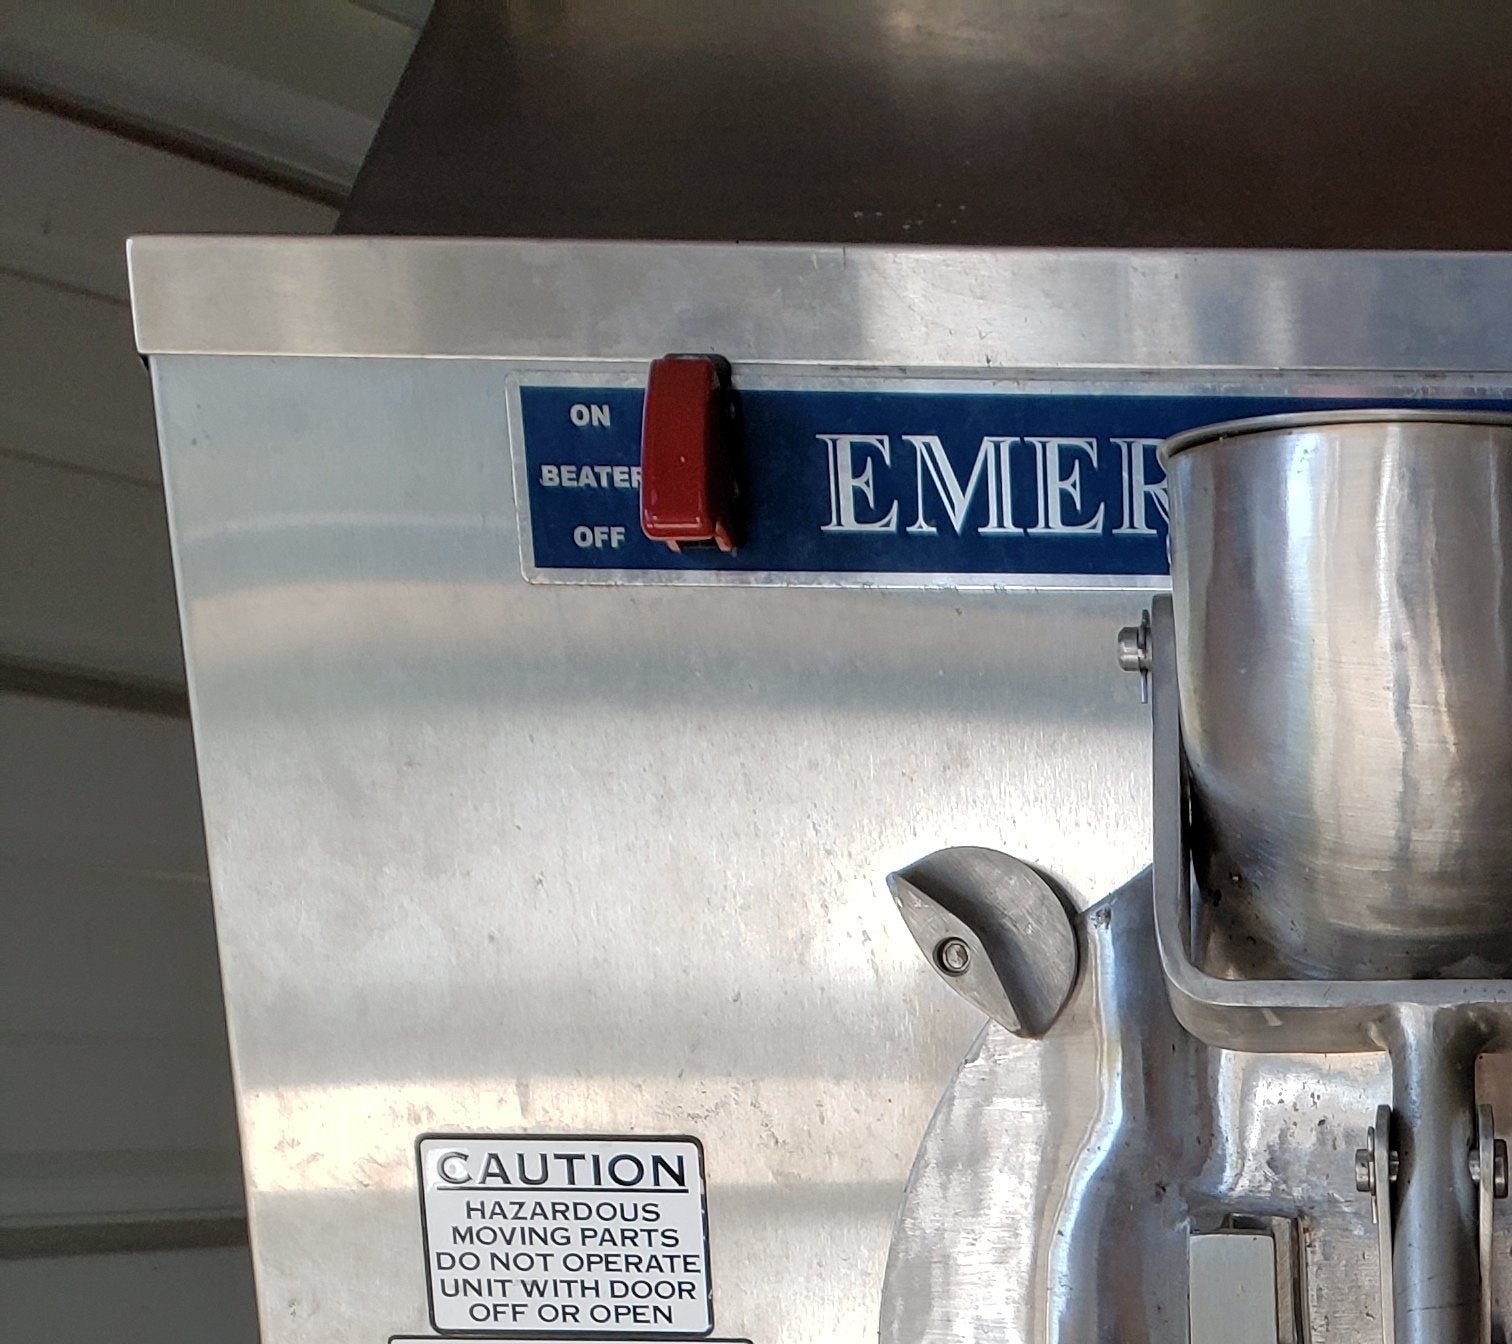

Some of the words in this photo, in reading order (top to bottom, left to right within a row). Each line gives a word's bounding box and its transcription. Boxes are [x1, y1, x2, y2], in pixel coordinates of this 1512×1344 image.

[570, 404, 610, 427] ON
[816, 435, 1169, 535] EMER
[574, 526, 625, 548] OFF
[436, 1152, 685, 1186] CAUTION
[466, 1201, 660, 1222] HAZARDOUS
[452, 1226, 571, 1246] MOVING
[581, 1228, 679, 1247] PARTS
[436, 1252, 480, 1270] DO
[490, 1253, 554, 1271] NOT
[563, 1253, 701, 1273] OPERATE
[440, 1279, 512, 1297] UNIT
[520, 1279, 599, 1298] WITH
[610, 1280, 696, 1299] DOOR
[469, 1303, 528, 1322] OFF
[538, 1304, 579, 1323] OR
[590, 1305, 672, 1323] OPEN
